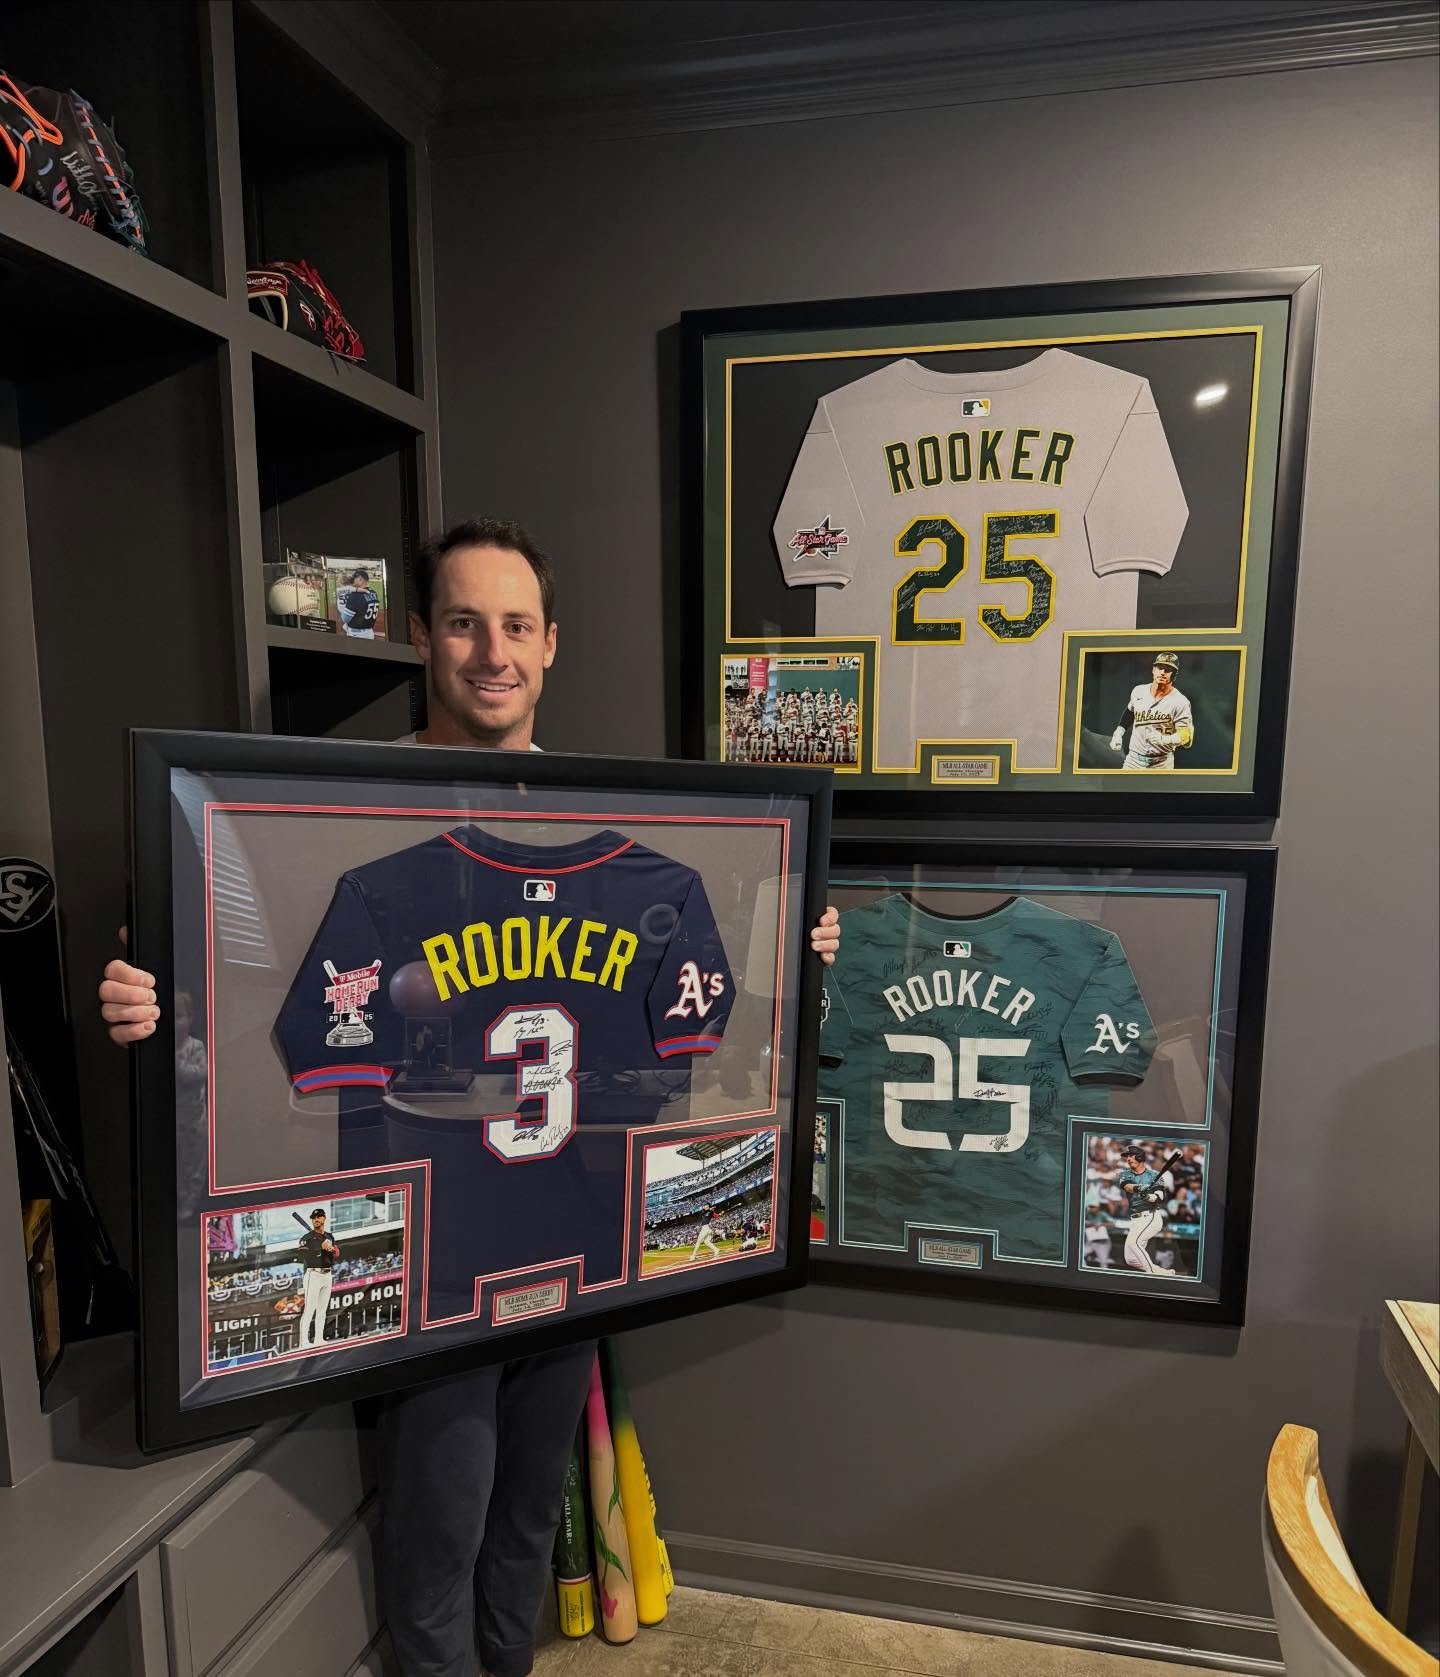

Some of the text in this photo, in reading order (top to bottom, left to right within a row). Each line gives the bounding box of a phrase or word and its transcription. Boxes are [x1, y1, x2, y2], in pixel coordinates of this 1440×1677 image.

[883, 428, 1076, 495] ROOKER
[892, 509, 1060, 645] 25
[347, 970, 371, 982] Mobile
[422, 915, 639, 1002] ROOKER
[326, 978, 378, 1002] HOME RUN
[335, 993, 369, 1013] DERBY
[664, 960, 725, 1021] A's
[882, 969, 1036, 1027] ROOKER
[1084, 1013, 1140, 1054] A's
[482, 1002, 580, 1164] 3
[883, 1033, 1032, 1153] 25
[214, 1312, 260, 1333] LIGHT
